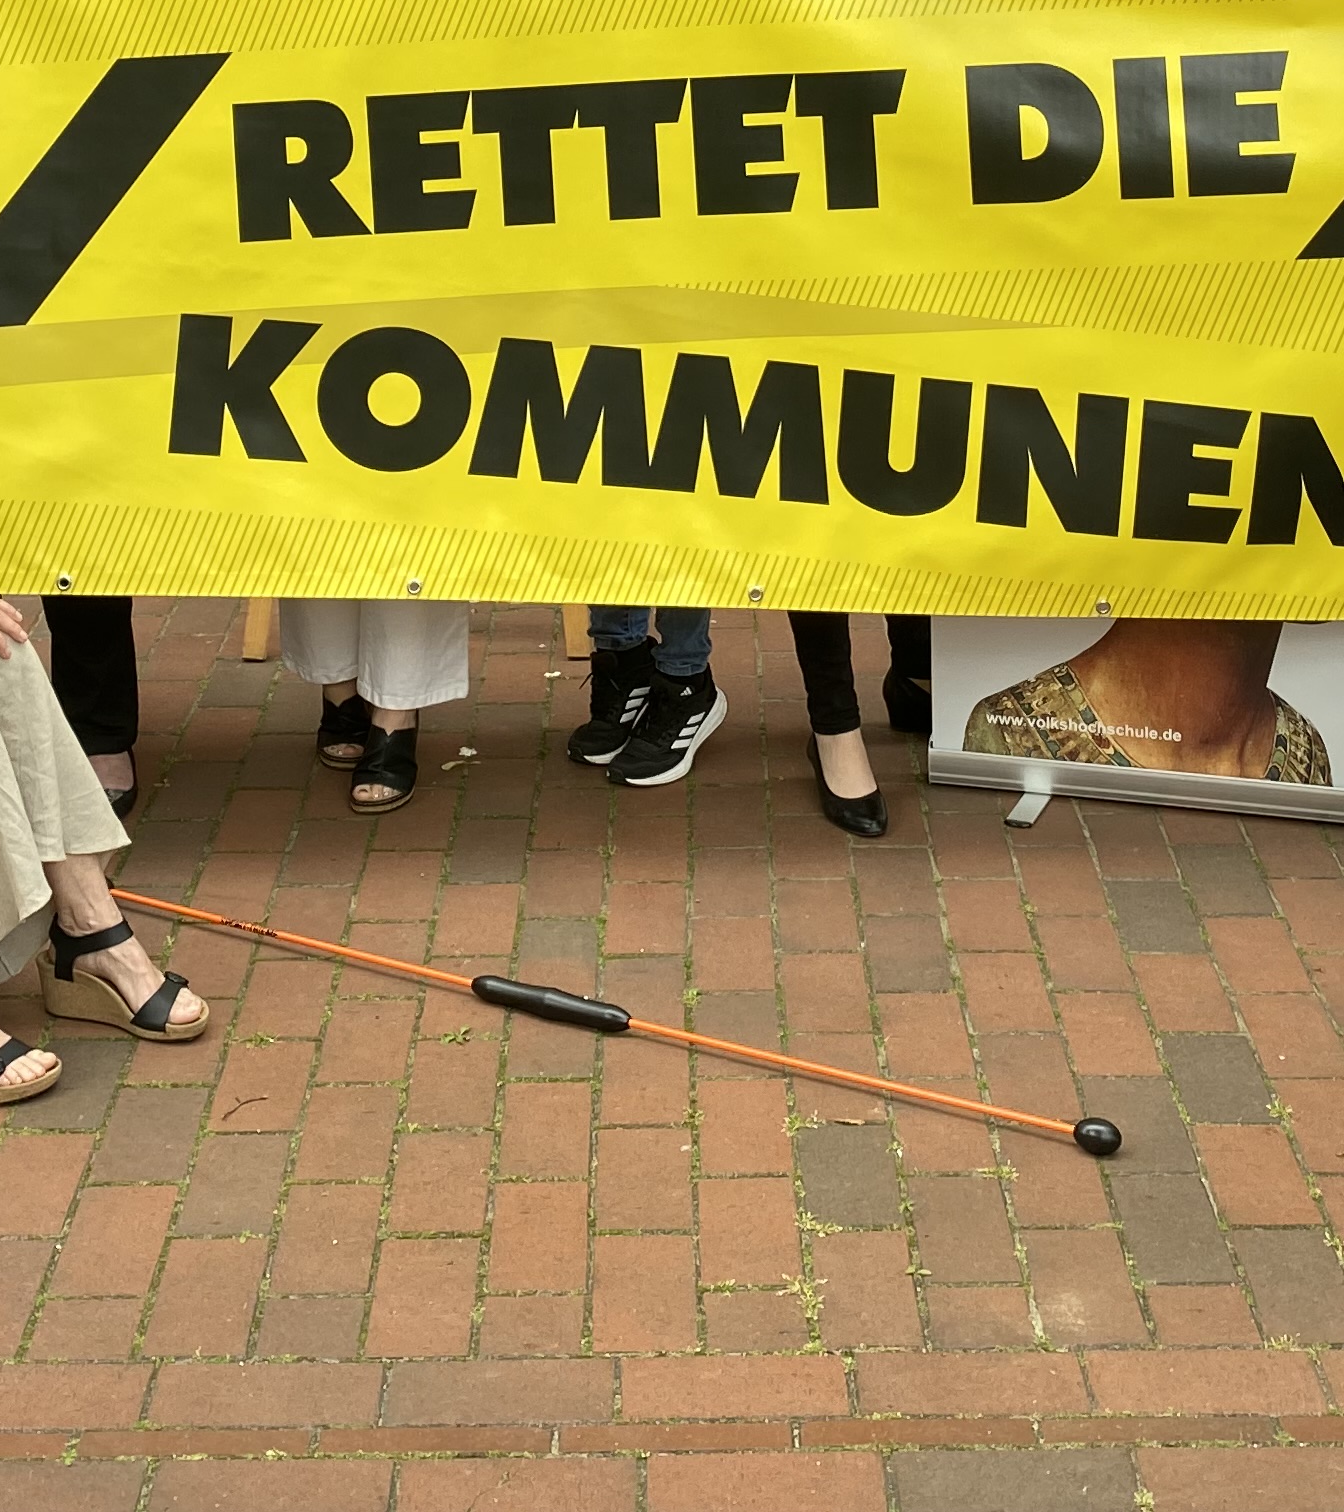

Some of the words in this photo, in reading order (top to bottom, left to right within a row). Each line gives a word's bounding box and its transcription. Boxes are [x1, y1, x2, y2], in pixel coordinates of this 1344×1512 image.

[232, 68, 905, 243] RETTET
[965, 50, 1296, 206] DIE
[986, 712, 1182, 742] www.volkshochschule.de
